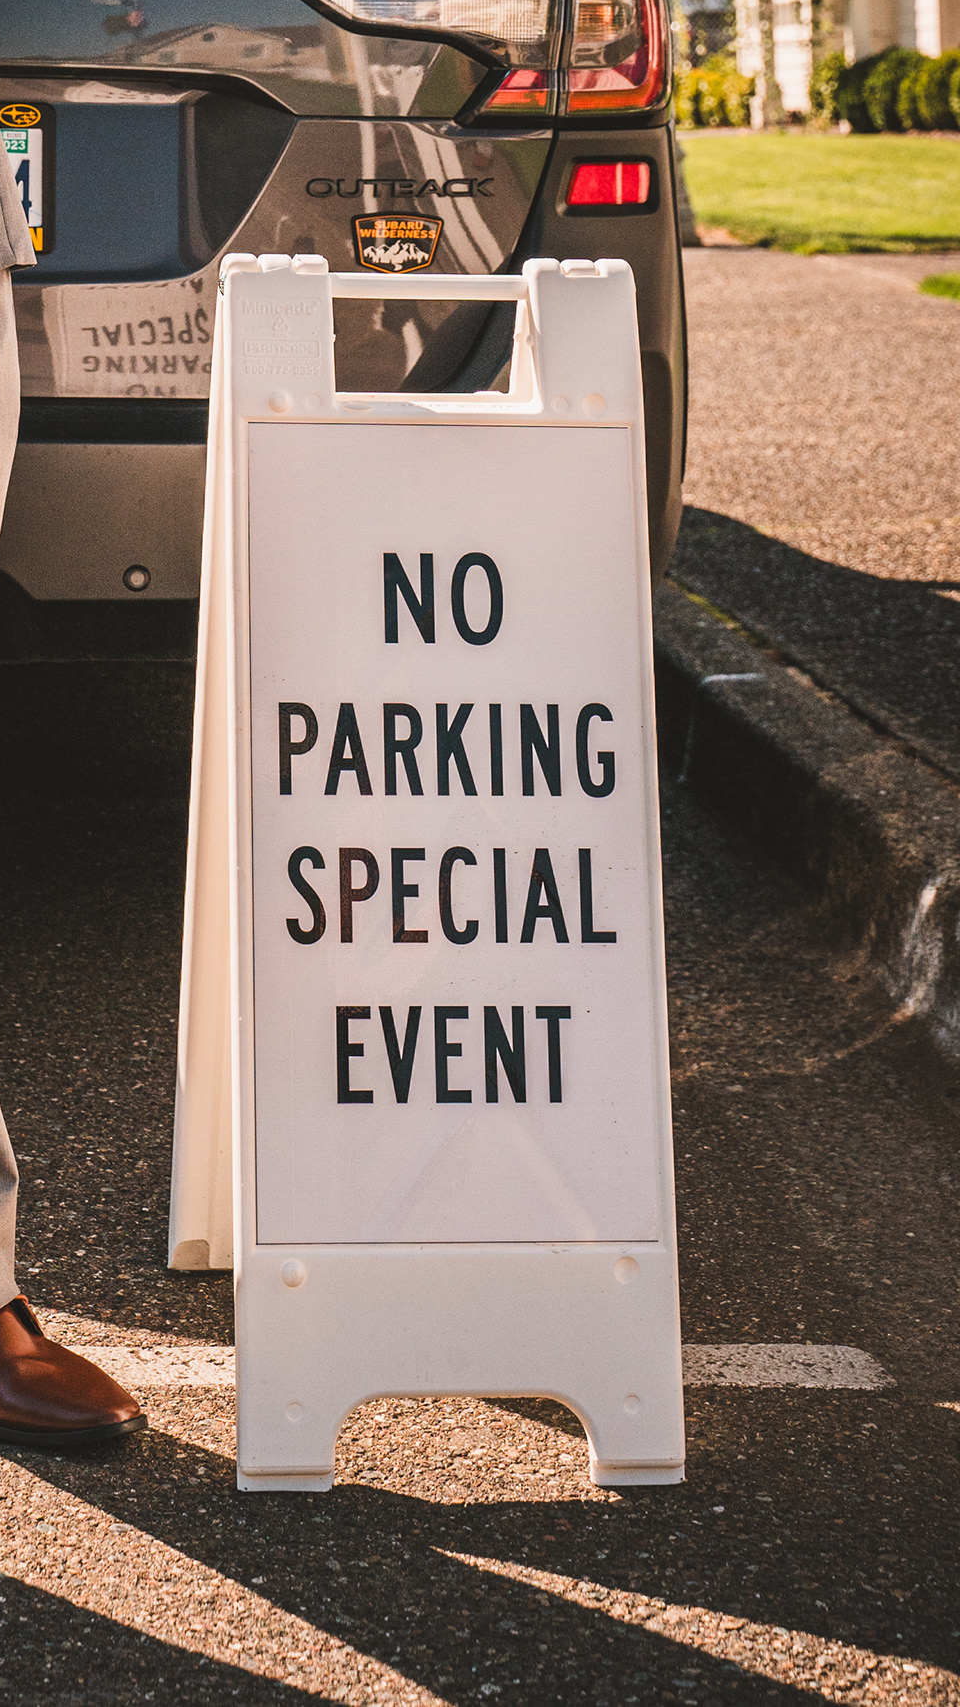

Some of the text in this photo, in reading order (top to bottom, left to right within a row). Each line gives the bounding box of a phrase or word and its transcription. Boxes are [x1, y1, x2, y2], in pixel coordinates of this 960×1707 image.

[3, 139, 26, 151] 023
[306, 178, 495, 198] OUTBACK
[360, 228, 437, 239] WILDERNESS
[374, 220, 424, 230] SUBARU
[81, 307, 210, 347] SPECIAL
[383, 552, 504, 645] NO
[278, 702, 616, 798] PARKING
[285, 846, 617, 944] SPECIAL
[336, 1005, 572, 1104] EVENT
